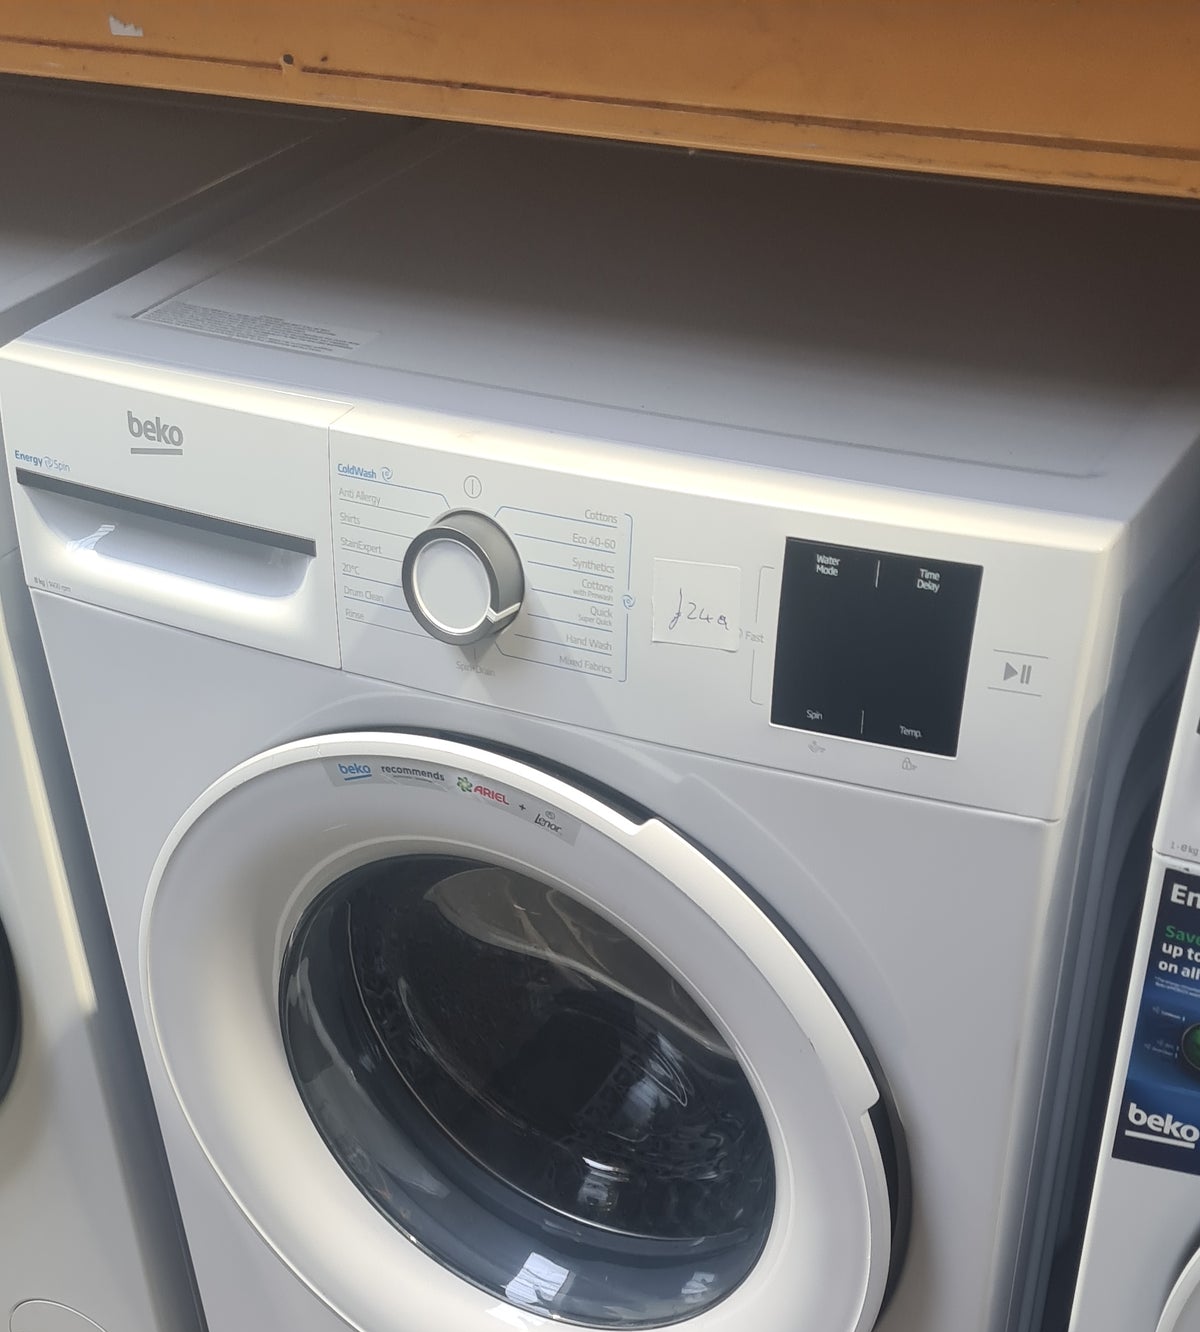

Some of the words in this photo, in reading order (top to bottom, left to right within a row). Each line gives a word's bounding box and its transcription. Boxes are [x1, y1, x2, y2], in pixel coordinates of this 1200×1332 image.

[127, 410, 184, 447] beko
[14, 449, 43, 467] Energy
[53, 459, 71, 472] Spin
[337, 463, 377, 479] ColdWash
[355, 490, 381, 506] Allergy
[339, 511, 361, 525] Shirts
[584, 508, 618, 524] Cottons
[340, 536, 382, 555] StainExpert
[572, 533, 588, 545] Eco
[588, 536, 616, 550] 40-60
[572, 556, 615, 574] Synthetics
[816, 553, 840, 567] Water
[816, 564, 839, 577] Mode
[919, 567, 941, 581] Time
[581, 578, 614, 593] Cottons
[916, 578, 941, 594] Delay
[343, 585, 364, 598] Drum
[364, 590, 385, 603] Clean
[590, 606, 613, 619] Quick
[565, 634, 588, 648] Hand
[588, 638, 613, 652] Wash
[744, 630, 766, 644] Fast
[559, 655, 583, 669] Mixed
[584, 660, 613, 674] Fabrics
[806, 708, 823, 722] Spin
[338, 763, 372, 776] beko
[380, 765, 446, 782] recommends
[474, 785, 510, 805] ARIEL
[1161, 942, 1184, 959] up
[1158, 960, 1179, 975] on
[1127, 1103, 1200, 1141] beko
